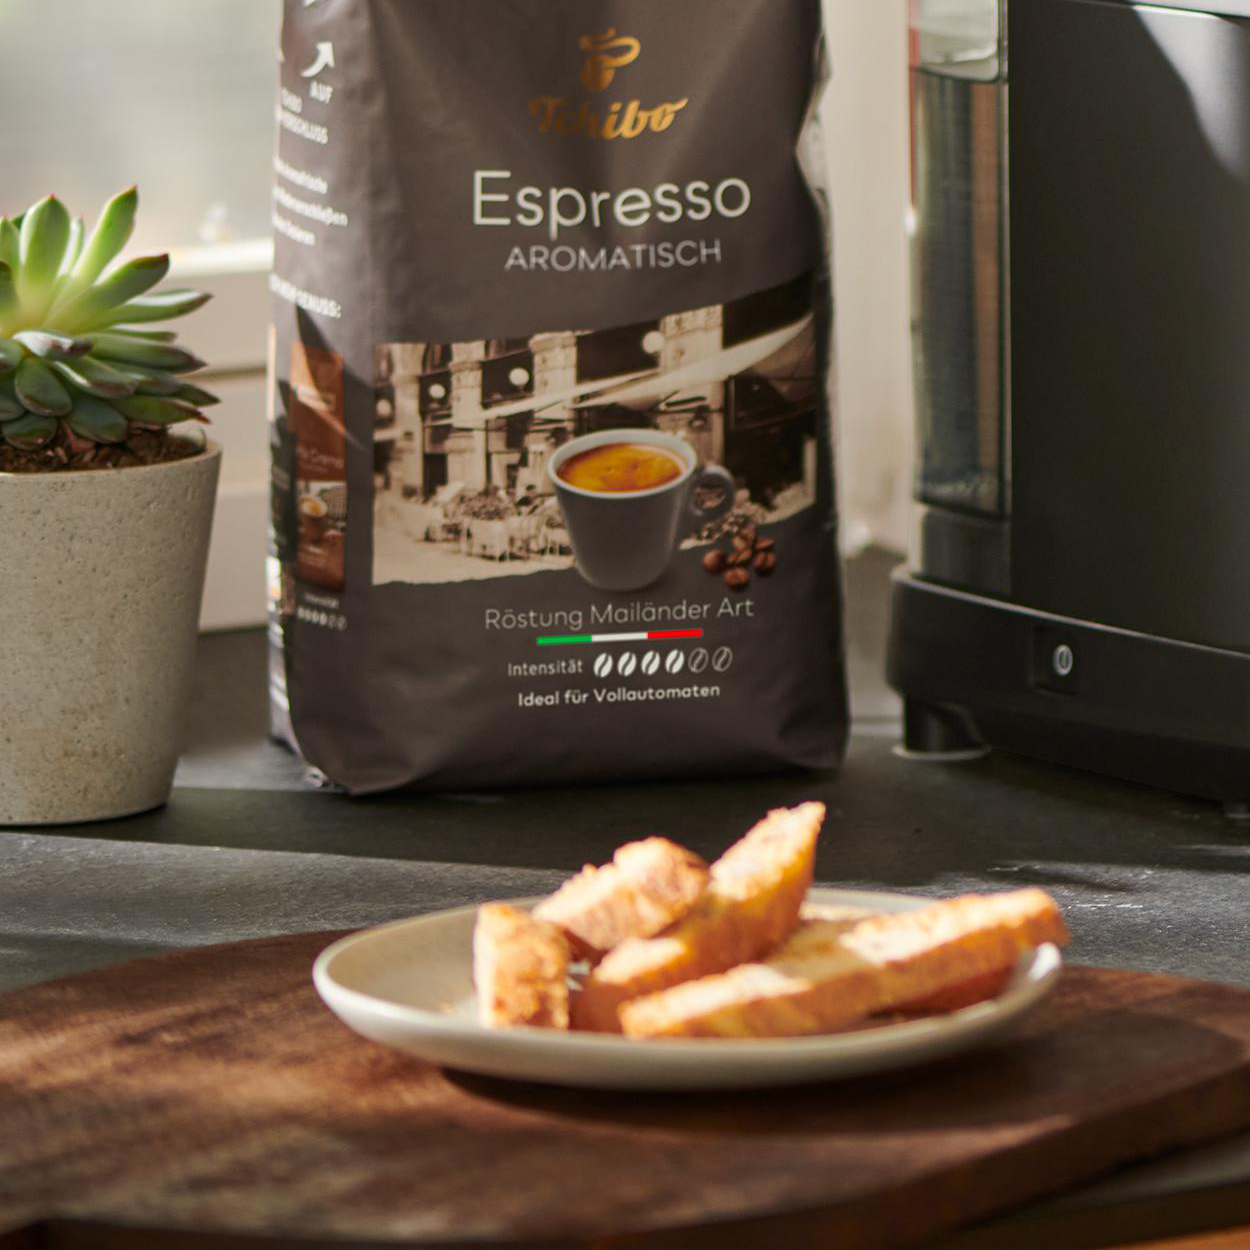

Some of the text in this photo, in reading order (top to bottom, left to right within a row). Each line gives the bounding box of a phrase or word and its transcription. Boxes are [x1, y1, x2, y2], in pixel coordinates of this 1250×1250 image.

[528, 96, 688, 140] Tchibo
[473, 169, 751, 241] Espresso
[504, 238, 722, 272] AROMATISCH
[485, 597, 755, 631] Röstung Mailänder Art
[508, 659, 583, 677] Intensität
[518, 683, 720, 707] Ideal für Vollautomaten
